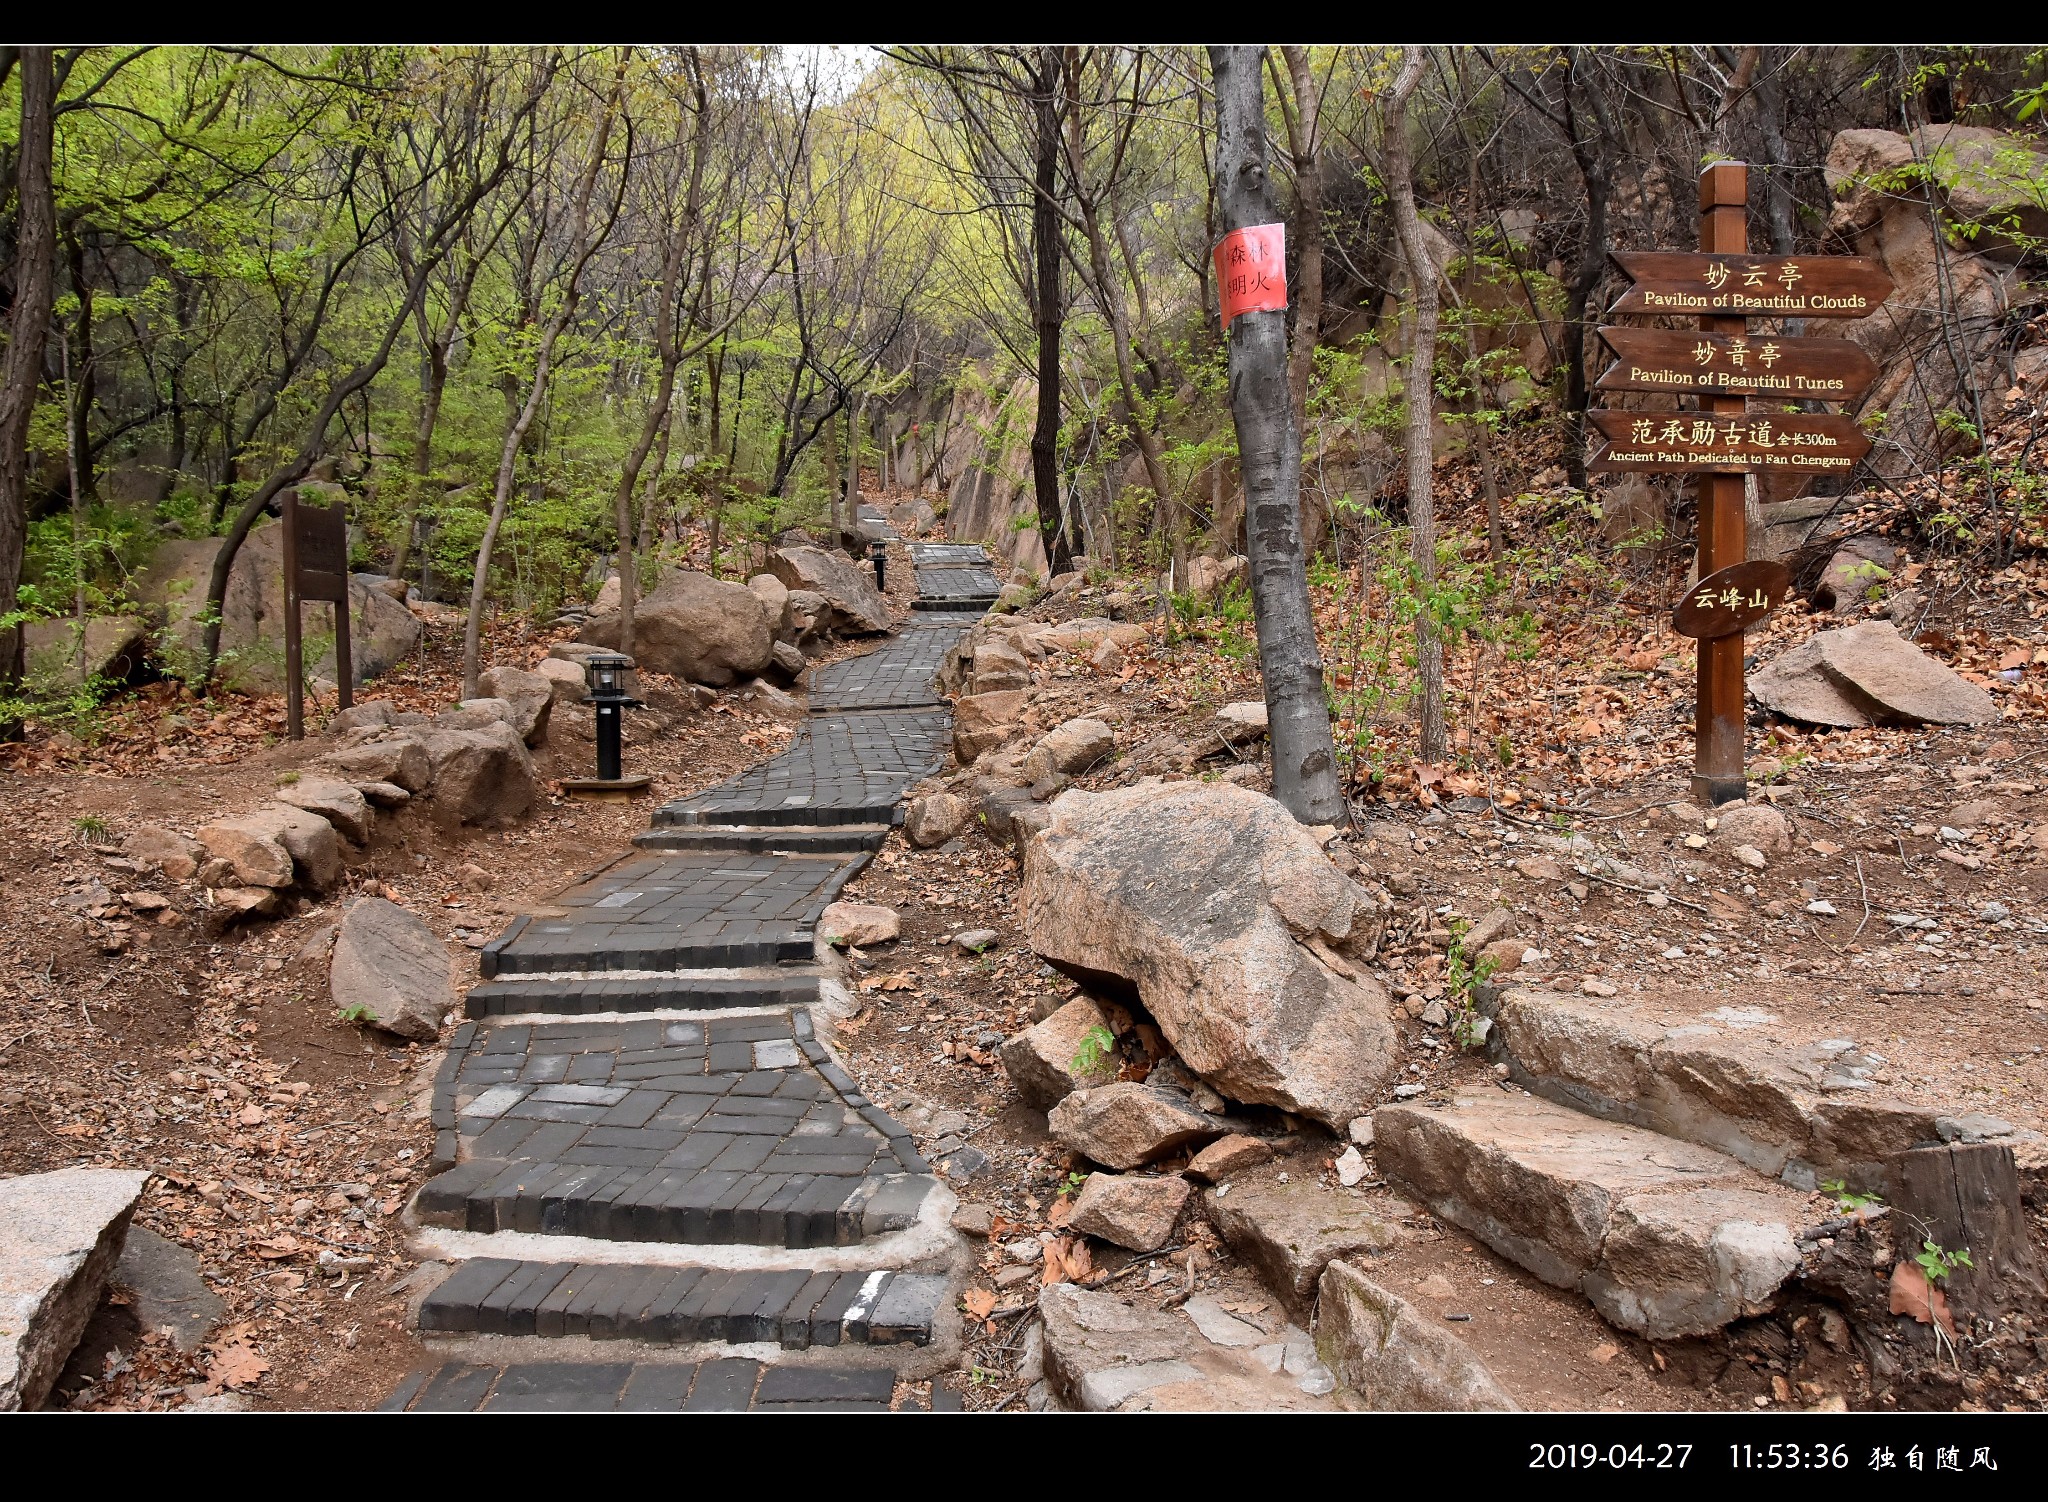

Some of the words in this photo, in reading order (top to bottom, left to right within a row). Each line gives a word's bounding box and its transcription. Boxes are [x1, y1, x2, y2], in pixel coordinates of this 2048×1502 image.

[1226, 241, 1269, 267] 森林
[1703, 262, 1802, 290] 妙云亭
[1644, 291, 1707, 307] Pavilion
[1712, 293, 1728, 308] of
[1732, 294, 1806, 309] Beautiful
[1811, 294, 1866, 308] Clouds
[1692, 340, 1781, 368] 妙音亭
[1630, 367, 1693, 385] Pavilion
[1698, 372, 1714, 386] of
[1718, 373, 1790, 389] Beautiful
[1795, 376, 1843, 390] Tunes
[1631, 419, 1775, 447] 范承勋古道
[1777, 432, 1837, 446] 全长300m
[1607, 450, 1654, 462] Ancient
[1657, 451, 1685, 463] Path
[1688, 451, 1748, 464] Dedicated
[1751, 454, 1760, 465] to
[1766, 453, 1789, 465] Fan
[1791, 454, 1851, 467] Chengxun
[1694, 586, 1768, 612] 云峰山
